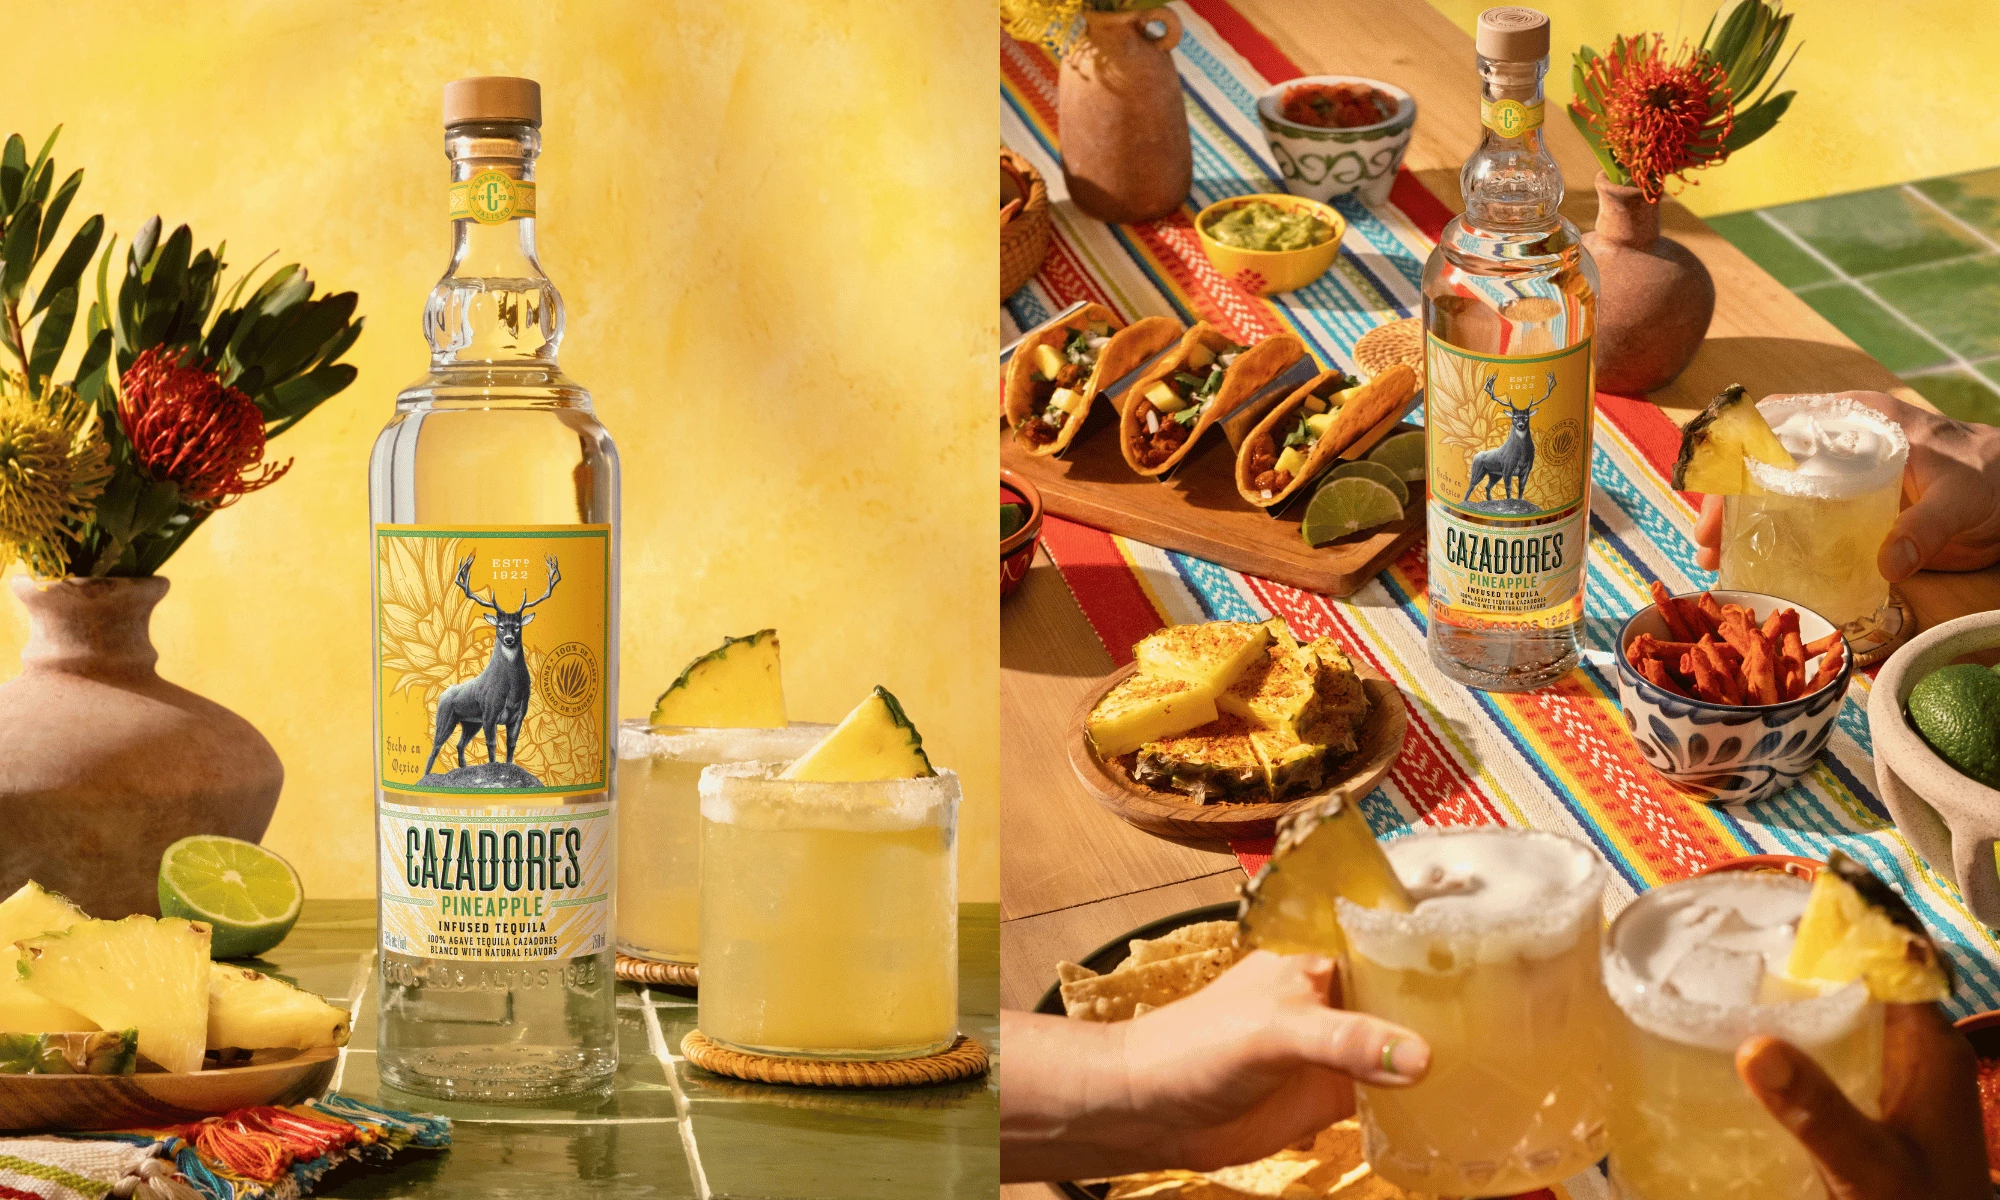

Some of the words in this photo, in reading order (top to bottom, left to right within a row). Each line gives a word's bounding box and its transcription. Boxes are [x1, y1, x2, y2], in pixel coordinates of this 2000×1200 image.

[1504, 108, 1512, 128] C
[475, 175, 511, 190] ARANDAS
[486, 182, 498, 212] C
[476, 207, 510, 220] JALISCO
[1446, 527, 1564, 574] CAZADORES
[492, 570, 529, 580] 1922
[1470, 573, 1537, 589] PINEAPPLE
[1468, 586, 1501, 598] INFUSED
[1505, 591, 1539, 600] TEQUILA
[1516, 597, 1546, 606] CAZADORES
[1462, 598, 1480, 608] BLANCO
[1524, 602, 1546, 610] FLAVORS
[1544, 609, 1571, 628] 1922
[556, 644, 577, 658] 100%
[580, 648, 588, 656] DE
[588, 658, 596, 684] AGAVE
[572, 693, 594, 712] ORIGEN
[387, 736, 406, 756] Hecho
[412, 745, 420, 754] en
[392, 758, 419, 776] Mexico
[406, 826, 581, 892] CAZADORES
[442, 896, 544, 918] PINEAPPLE
[438, 920, 490, 933] INFUSED
[496, 922, 546, 936] TEQUILA
[428, 934, 446, 944] 100%
[449, 936, 474, 946] AGAVE
[477, 937, 510, 947] TEQUILA
[514, 936, 558, 946] CAZADORES
[430, 946, 459, 956] BLANCO
[462, 947, 482, 957] WITH
[485, 948, 522, 957] NATURAL
[524, 946, 558, 956] FLAVORS
[559, 962, 596, 988] 1922
